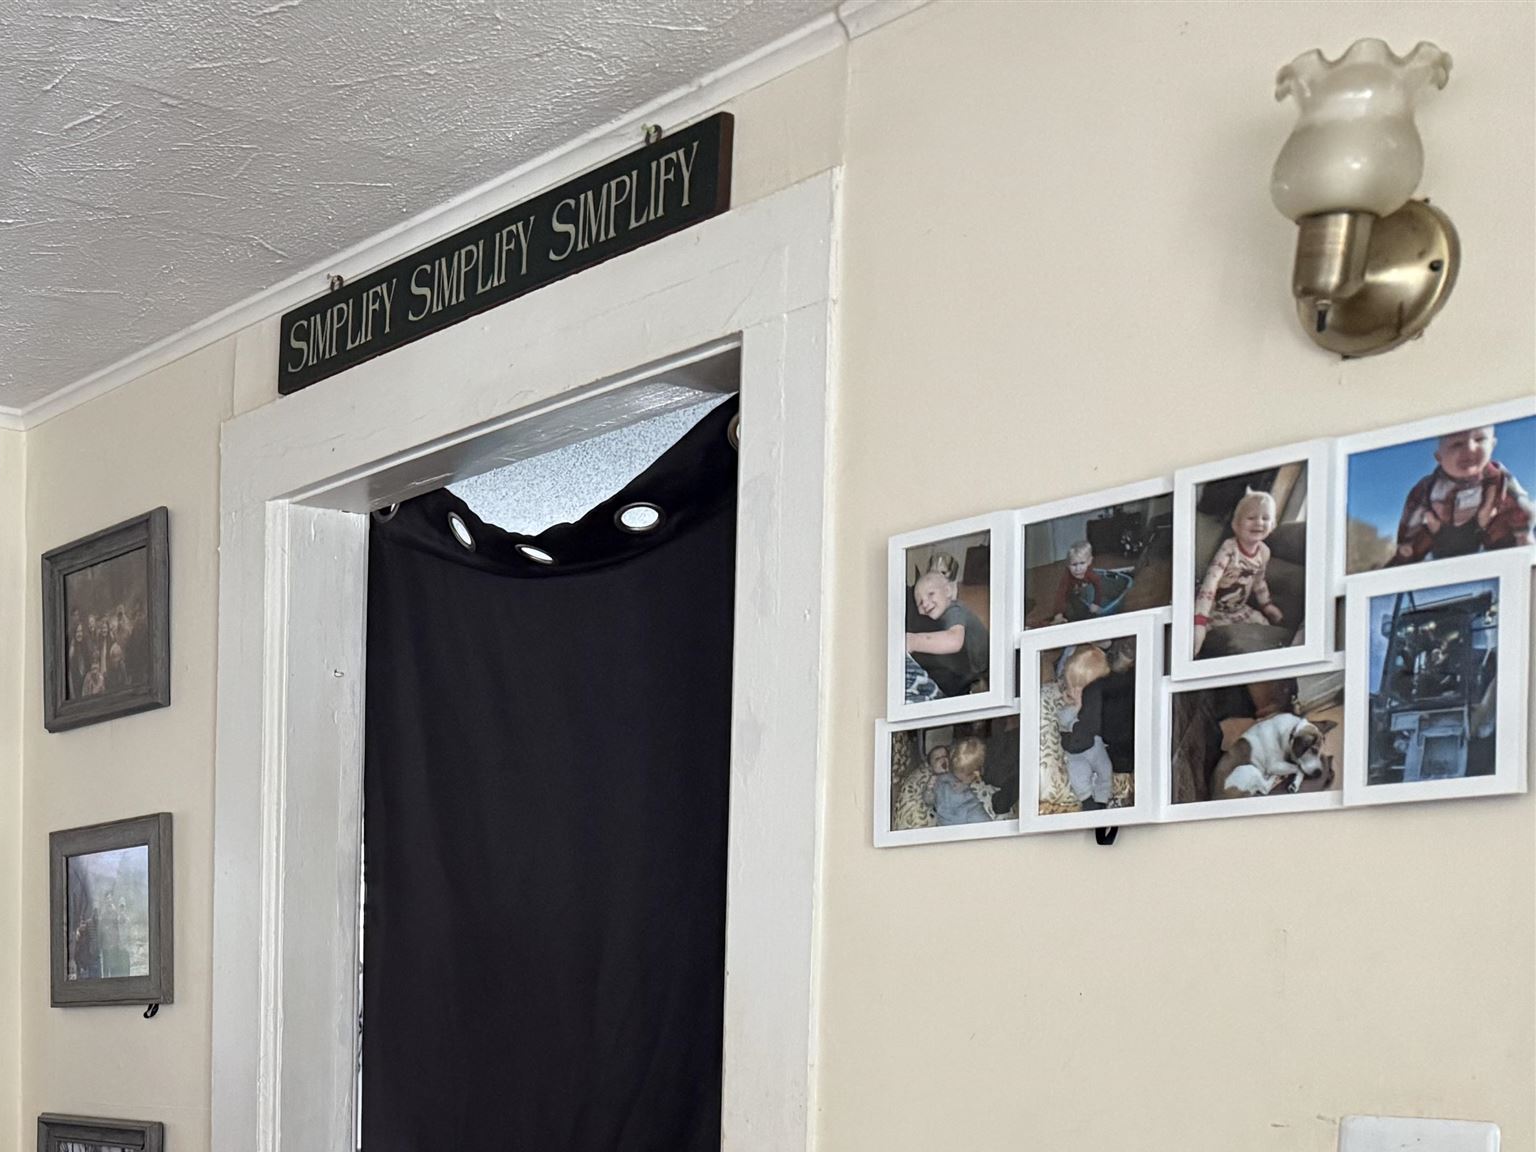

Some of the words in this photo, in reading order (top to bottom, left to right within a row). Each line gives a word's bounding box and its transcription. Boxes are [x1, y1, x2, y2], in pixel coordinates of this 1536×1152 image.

[287, 277, 398, 373] SIMPLIFY
[407, 216, 536, 322] SIMPLIFY
[548, 141, 700, 262] SIMPLIFY
